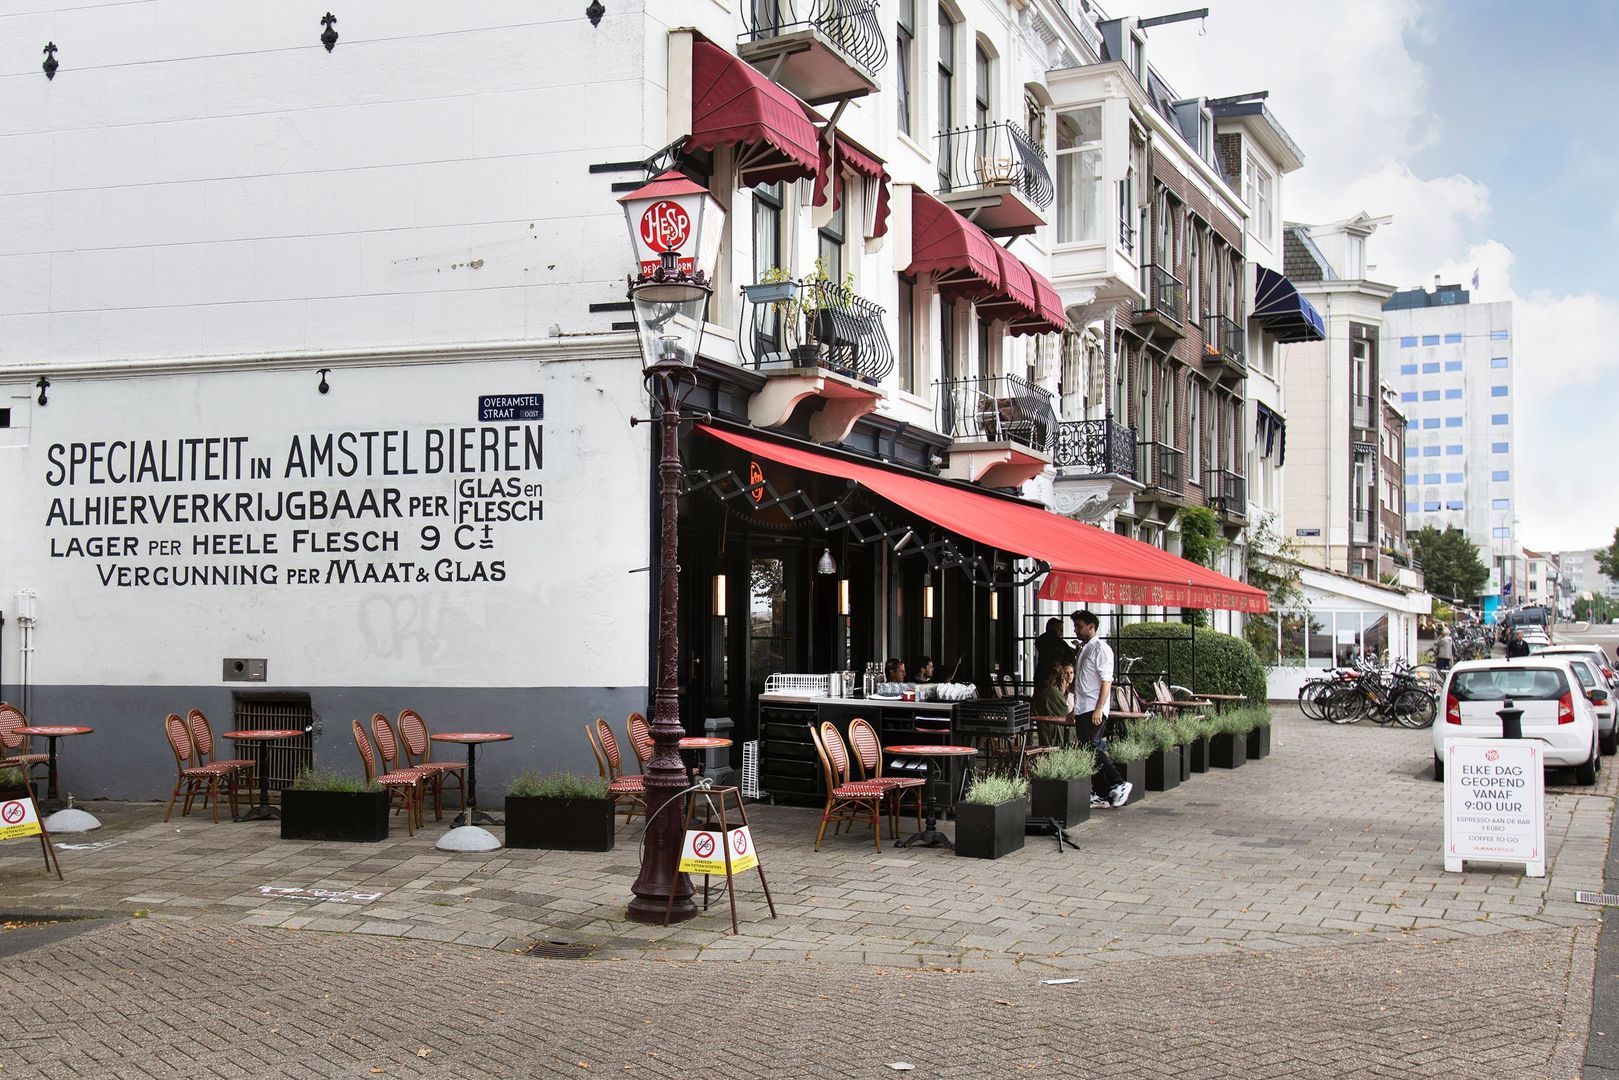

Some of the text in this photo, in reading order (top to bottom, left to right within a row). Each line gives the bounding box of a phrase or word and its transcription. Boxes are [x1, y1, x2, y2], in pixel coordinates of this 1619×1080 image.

[644, 202, 688, 250] HESP
[643, 266, 652, 274] DE
[484, 397, 539, 407] OVERAMSTEL
[484, 409, 514, 418] STRAAT
[45, 424, 544, 487] SPECIALITEIT IN AMSTELBIEREN
[458, 478, 543, 499] GLAS en
[45, 487, 451, 528] ALHIERVERKRIJGBAAR PER
[458, 499, 543, 525] FLESCH
[50, 534, 139, 558] LAGER
[148, 540, 182, 556] PER
[192, 531, 279, 555] HEELE
[292, 529, 400, 553] FLESCH
[420, 525, 441, 551] 9
[96, 558, 506, 587] VERGUNNING PER MAAT & GLAS
[1462, 765, 1523, 776] ELKE DAG
[1461, 776, 1525, 788] GEOPEND
[1473, 789, 1512, 799] VANAF
[1464, 800, 1522, 812] 9:00 UUR
